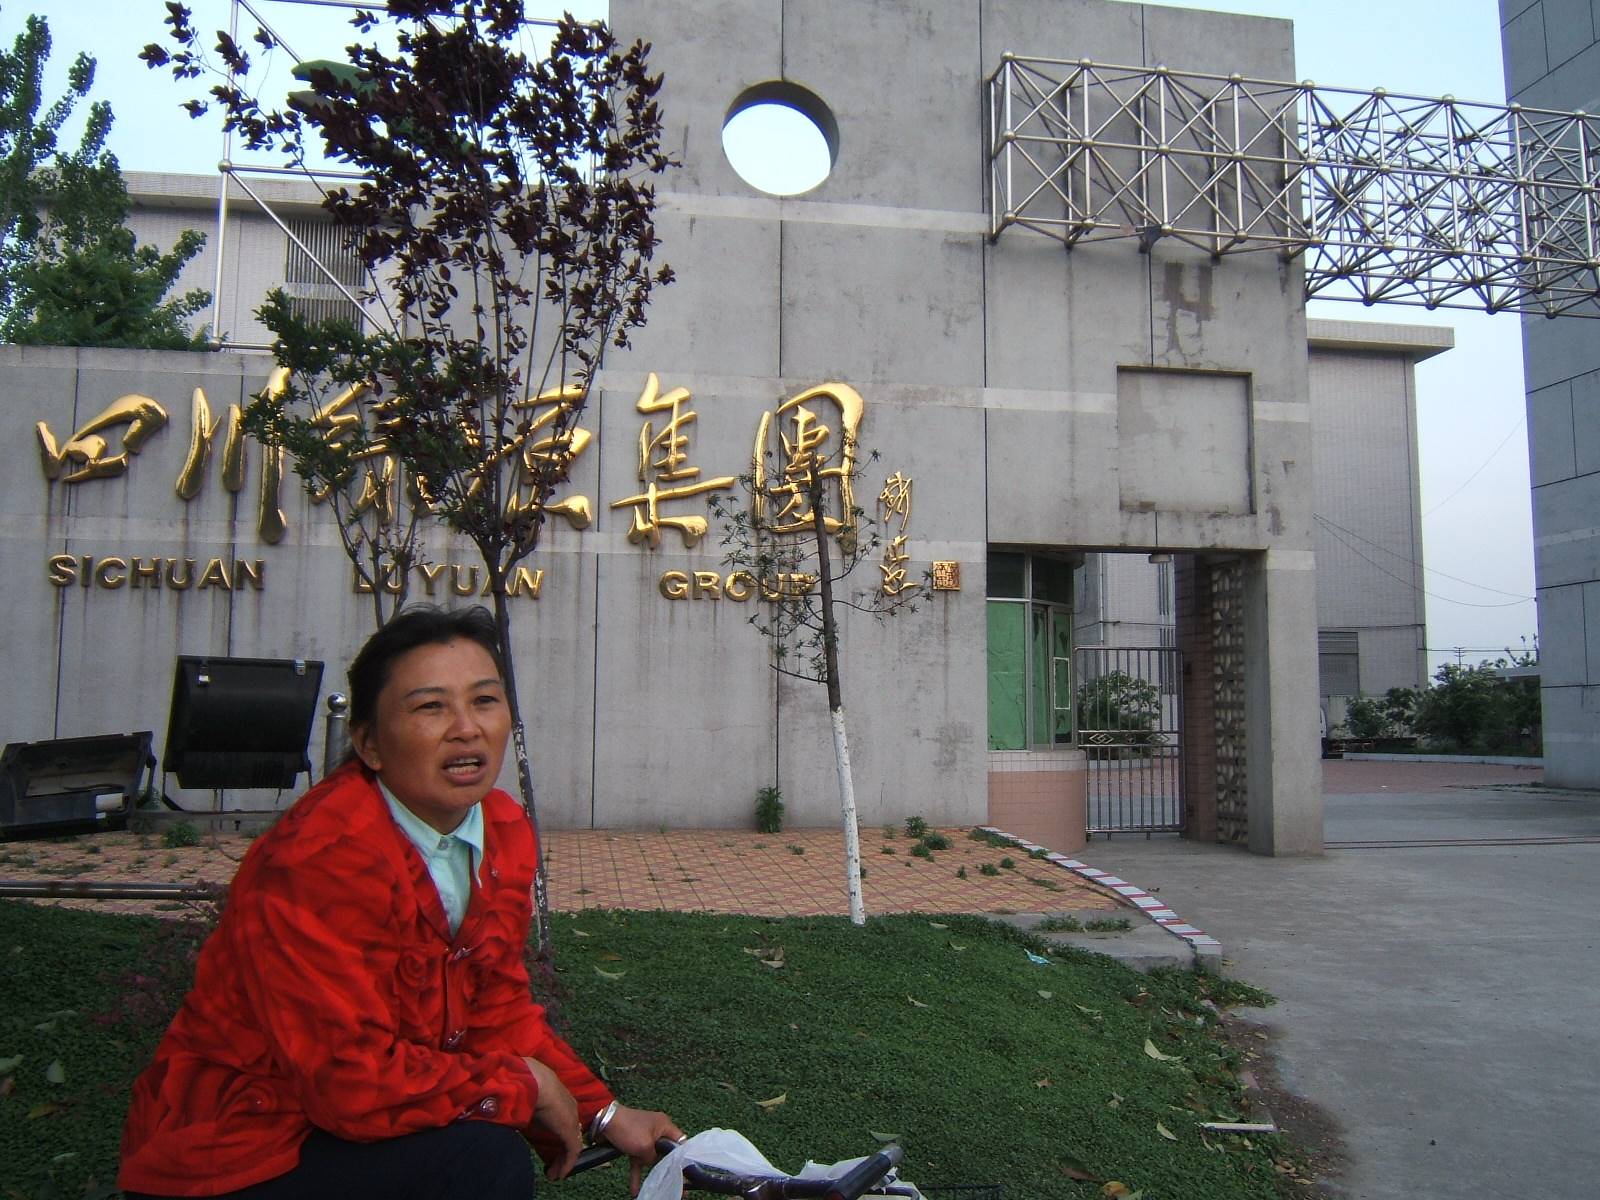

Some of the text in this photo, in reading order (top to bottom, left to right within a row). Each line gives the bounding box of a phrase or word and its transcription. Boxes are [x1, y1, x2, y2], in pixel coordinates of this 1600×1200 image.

[49, 554, 816, 602] SICHUAN LUYUAN GROUP
